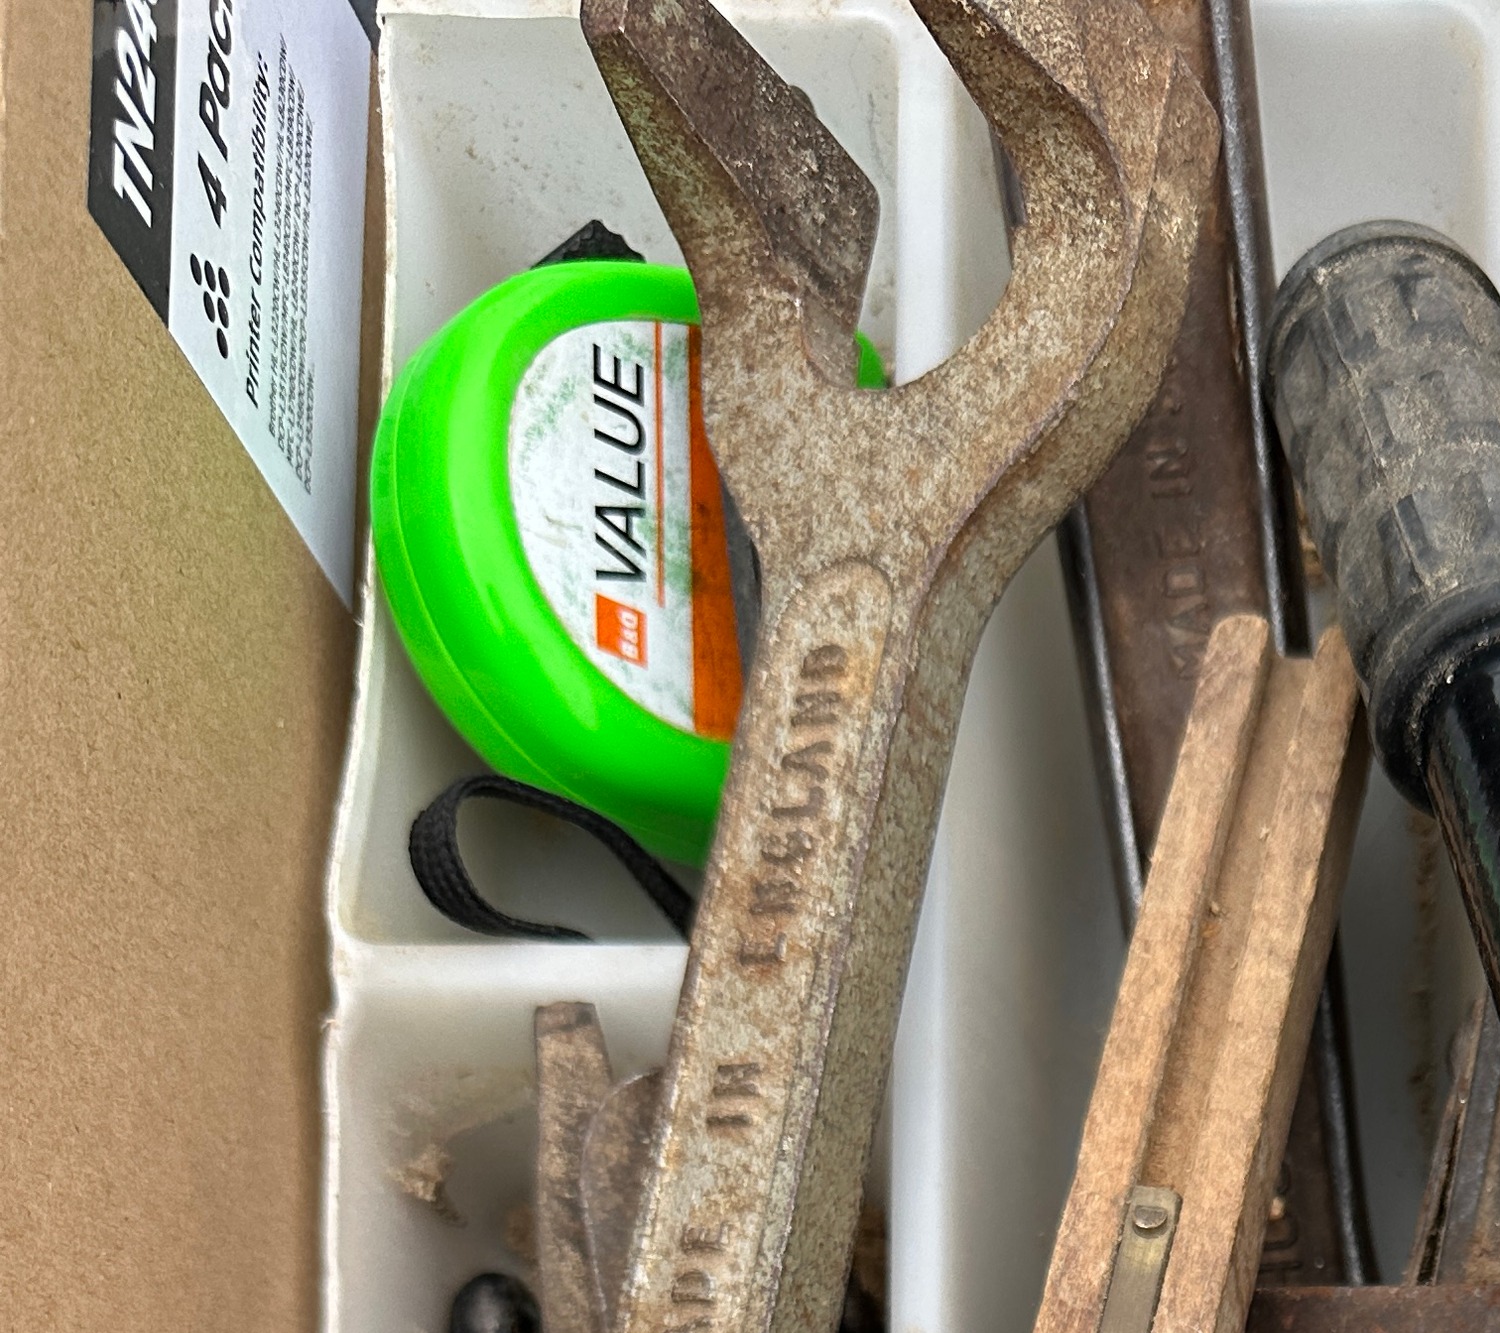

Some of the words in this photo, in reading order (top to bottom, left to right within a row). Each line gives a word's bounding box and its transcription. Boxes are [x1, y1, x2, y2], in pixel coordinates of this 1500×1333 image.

[114, 0, 158, 228] TN24
[198, 150, 228, 229] 4
[250, 50, 270, 286] Compatibility:
[246, 286, 262, 409] Printer
[269, 376, 279, 438] Brother
[593, 343, 648, 584] VALUE
[1146, 444, 1192, 501] IN
[1154, 525, 1208, 682] MADE
[705, 1062, 761, 1129] IN
[738, 644, 848, 967] ENGLAND
